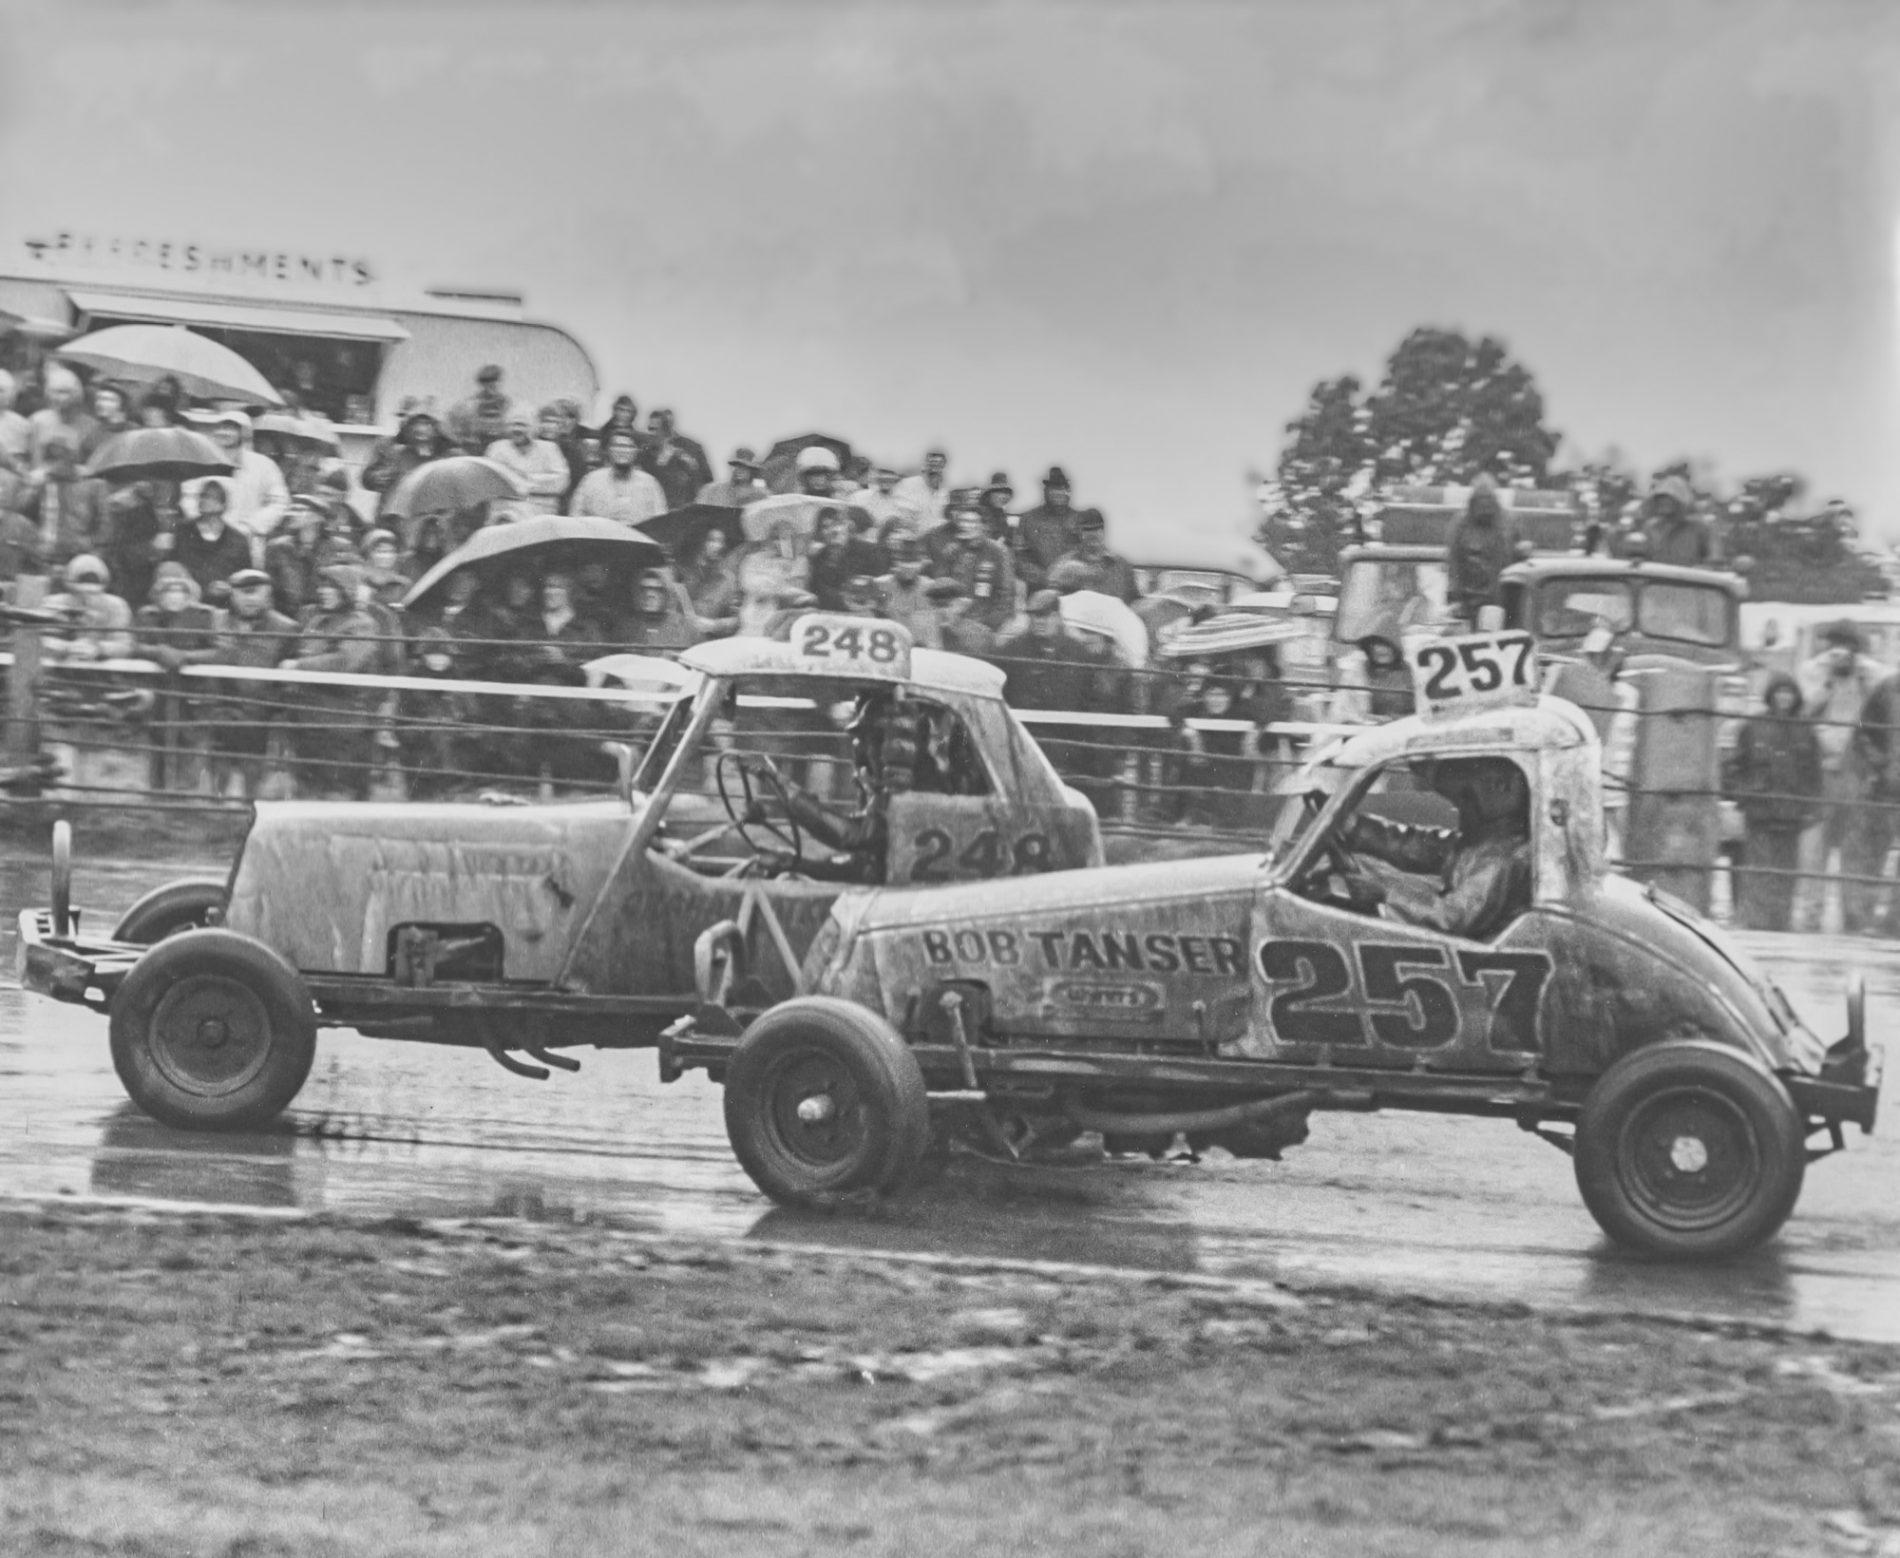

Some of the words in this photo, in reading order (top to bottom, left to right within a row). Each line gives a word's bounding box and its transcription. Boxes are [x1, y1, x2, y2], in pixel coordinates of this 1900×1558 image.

[55, 230, 374, 287] ESHMENTS
[803, 625, 897, 663] 248
[1416, 636, 1534, 700] 257
[922, 930, 1019, 965] BOB
[1026, 930, 1242, 974] TANSER
[1256, 938, 1555, 1057] 257
